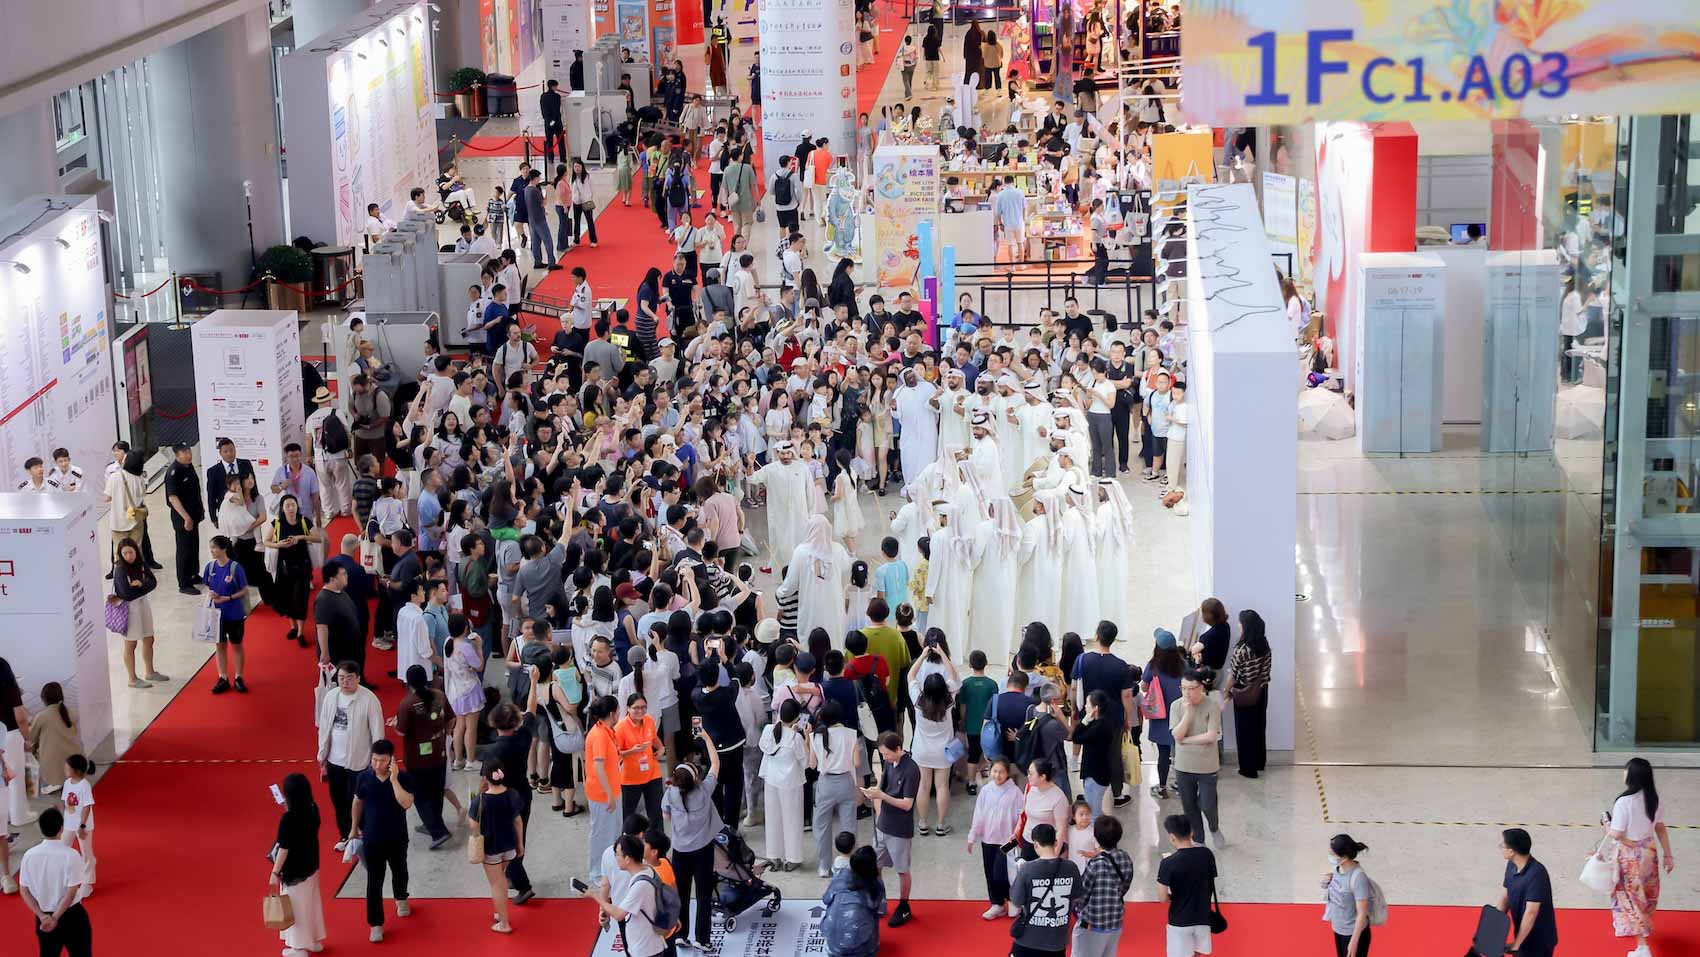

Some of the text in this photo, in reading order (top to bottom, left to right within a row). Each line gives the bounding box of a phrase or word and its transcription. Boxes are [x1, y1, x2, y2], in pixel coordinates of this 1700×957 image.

[1245, 29, 1570, 107] 1F C1.A03
[910, 169, 933, 177] 绘本展
[211, 382, 215, 393] 1
[257, 400, 265, 412] 2
[212, 419, 221, 431] 3
[1032, 879, 1051, 887] WOO
[1029, 916, 1069, 927] SIMPSONS
[755, 922, 777, 957] BIBF绘本
